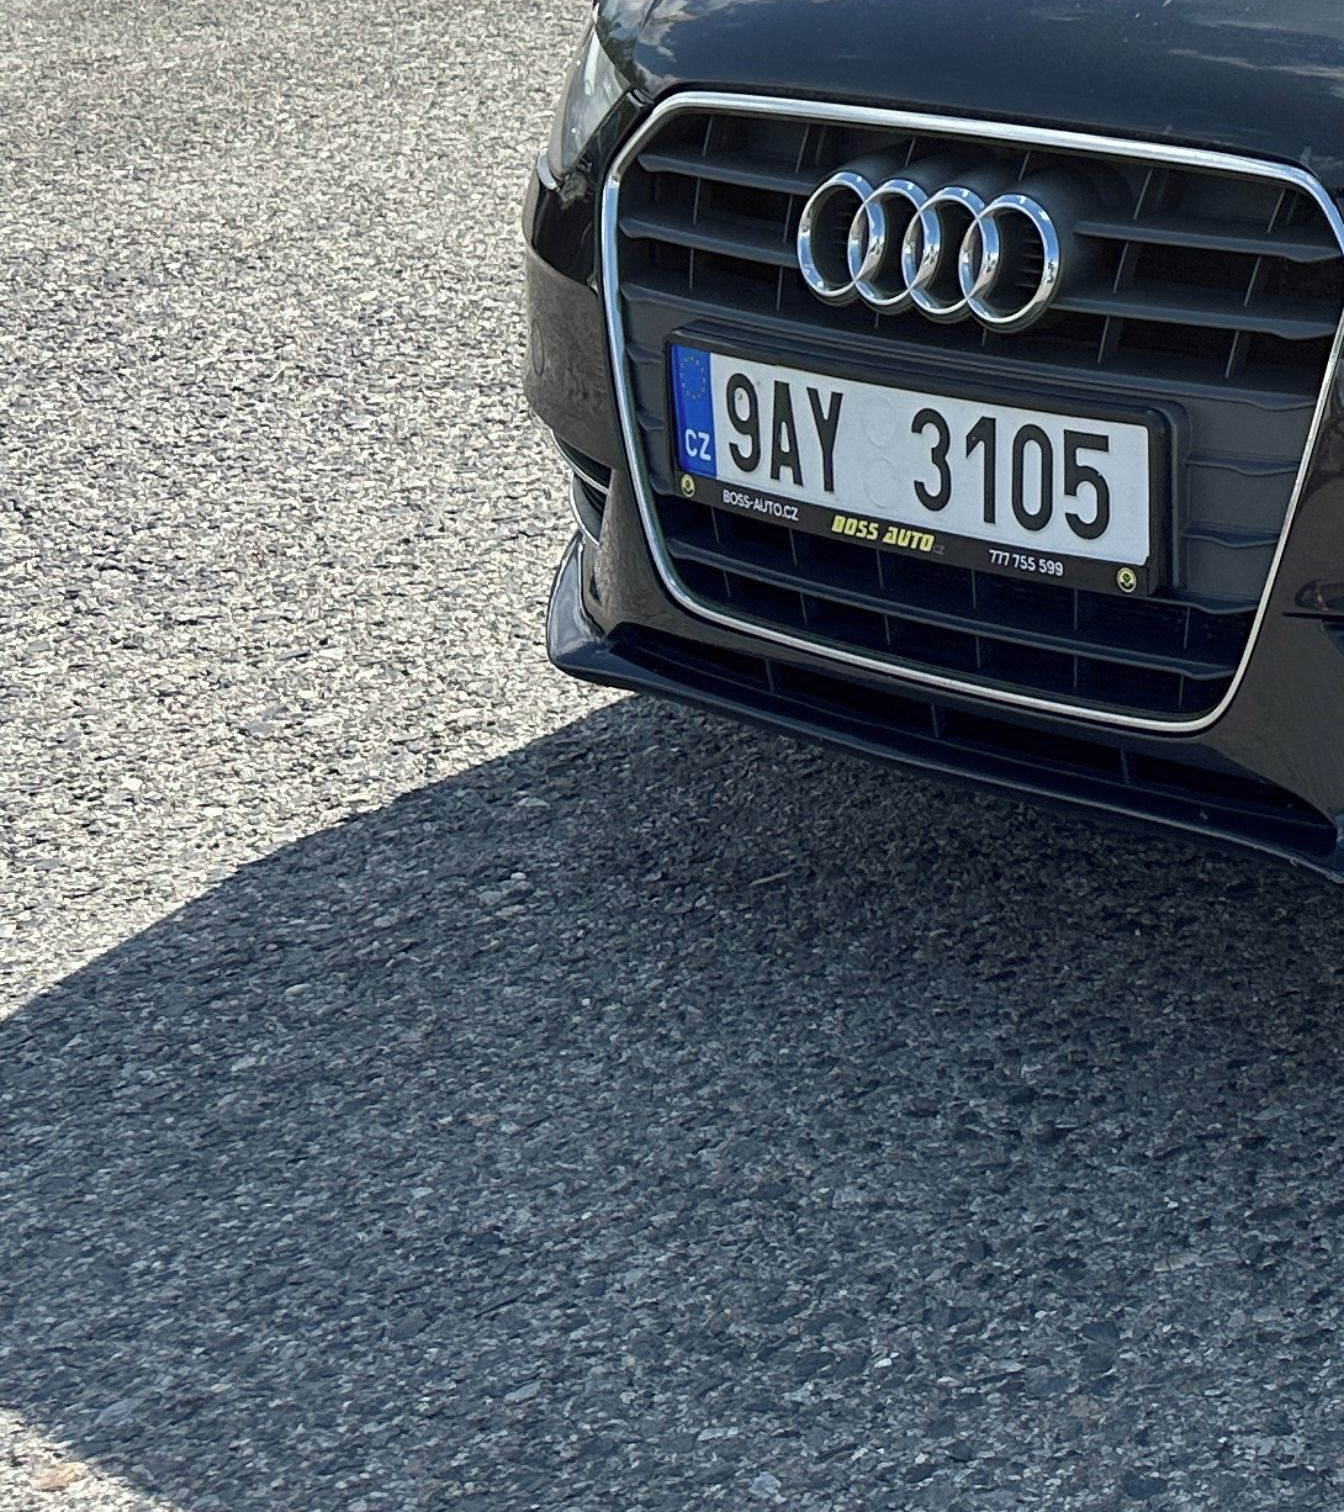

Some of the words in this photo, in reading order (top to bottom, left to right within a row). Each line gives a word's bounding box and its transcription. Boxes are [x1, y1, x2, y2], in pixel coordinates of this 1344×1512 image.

[684, 428, 712, 462] CZ
[725, 372, 843, 493] 9AY
[911, 407, 1111, 541] 3105
[722, 489, 800, 521] BOSS-AUTO.CZ
[831, 515, 879, 540] BOSS
[883, 527, 935, 552] AUTO
[988, 549, 1010, 566] 777
[1014, 554, 1036, 572] 755
[1039, 559, 1063, 577] 599
